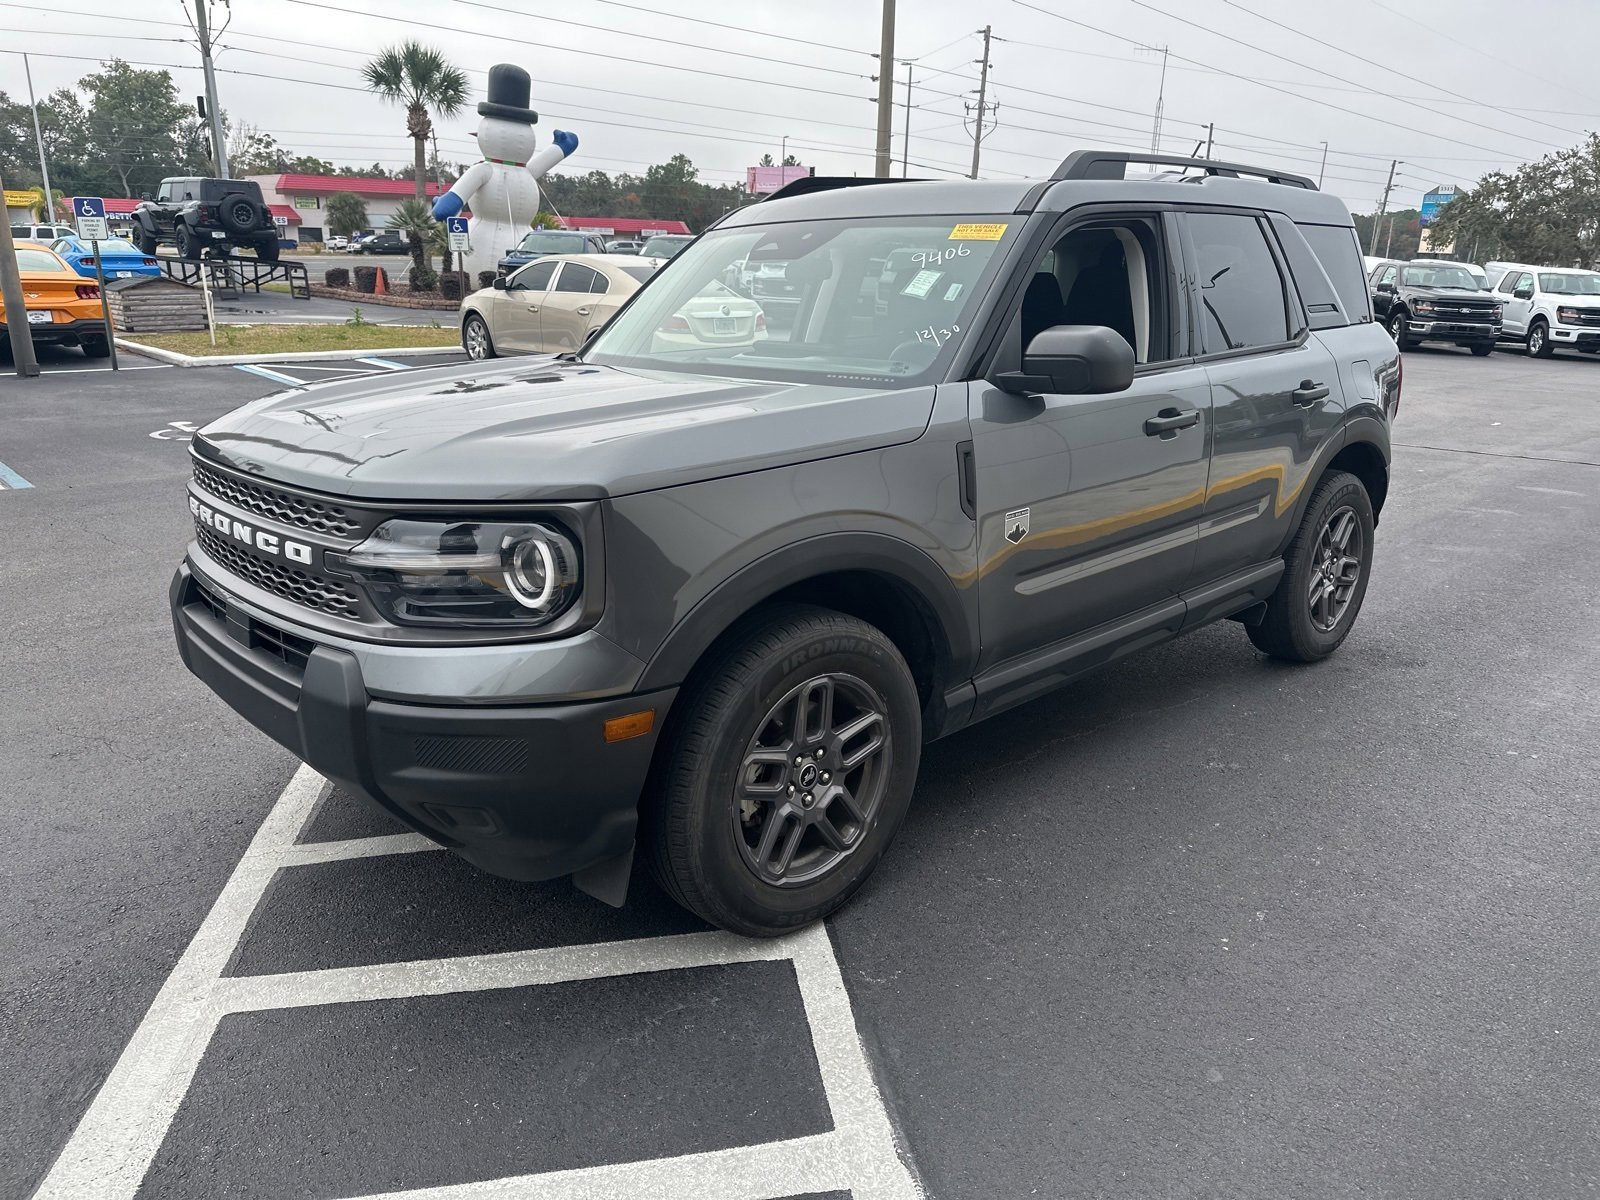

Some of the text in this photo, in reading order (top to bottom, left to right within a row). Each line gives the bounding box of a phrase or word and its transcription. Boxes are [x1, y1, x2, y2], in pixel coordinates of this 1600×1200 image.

[911, 243, 971, 269] 9406
[915, 324, 960, 347] 12/30
[189, 496, 312, 565] BRONCO
